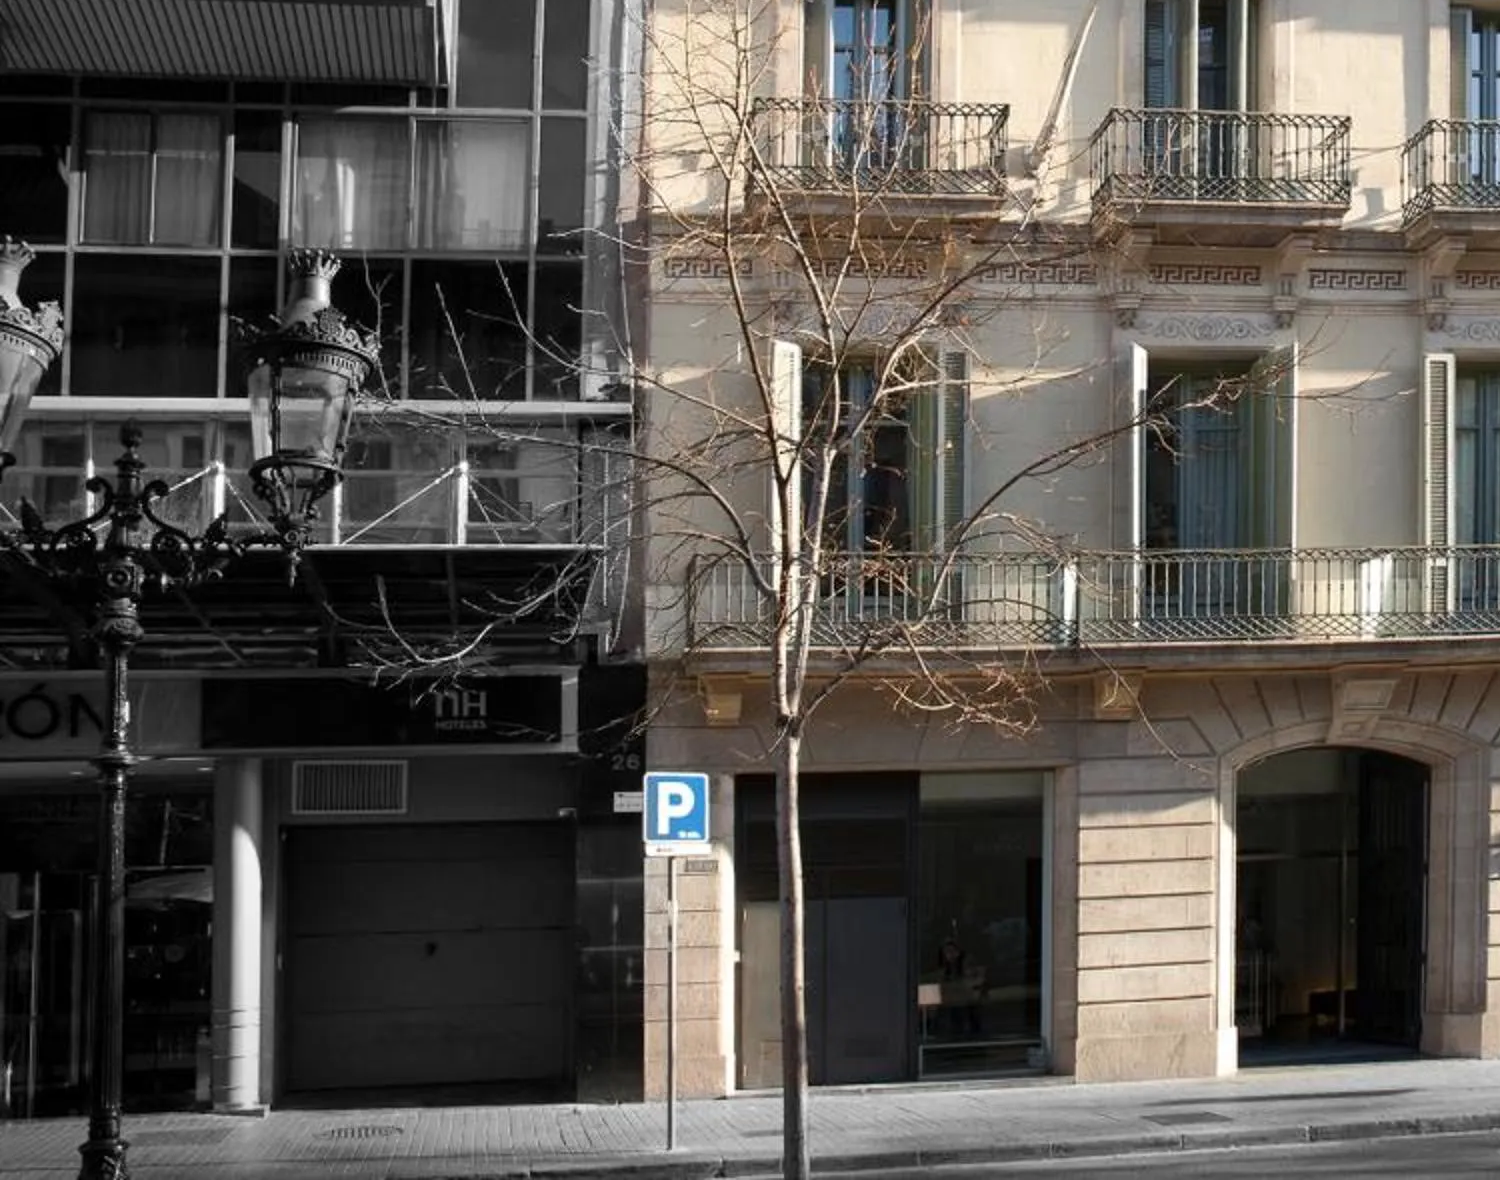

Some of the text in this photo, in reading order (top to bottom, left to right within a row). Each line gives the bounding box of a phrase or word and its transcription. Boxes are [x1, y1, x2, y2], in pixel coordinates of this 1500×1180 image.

[0, 682, 106, 740] ÓN
[611, 753, 641, 770] 26
[657, 781, 695, 835] P
